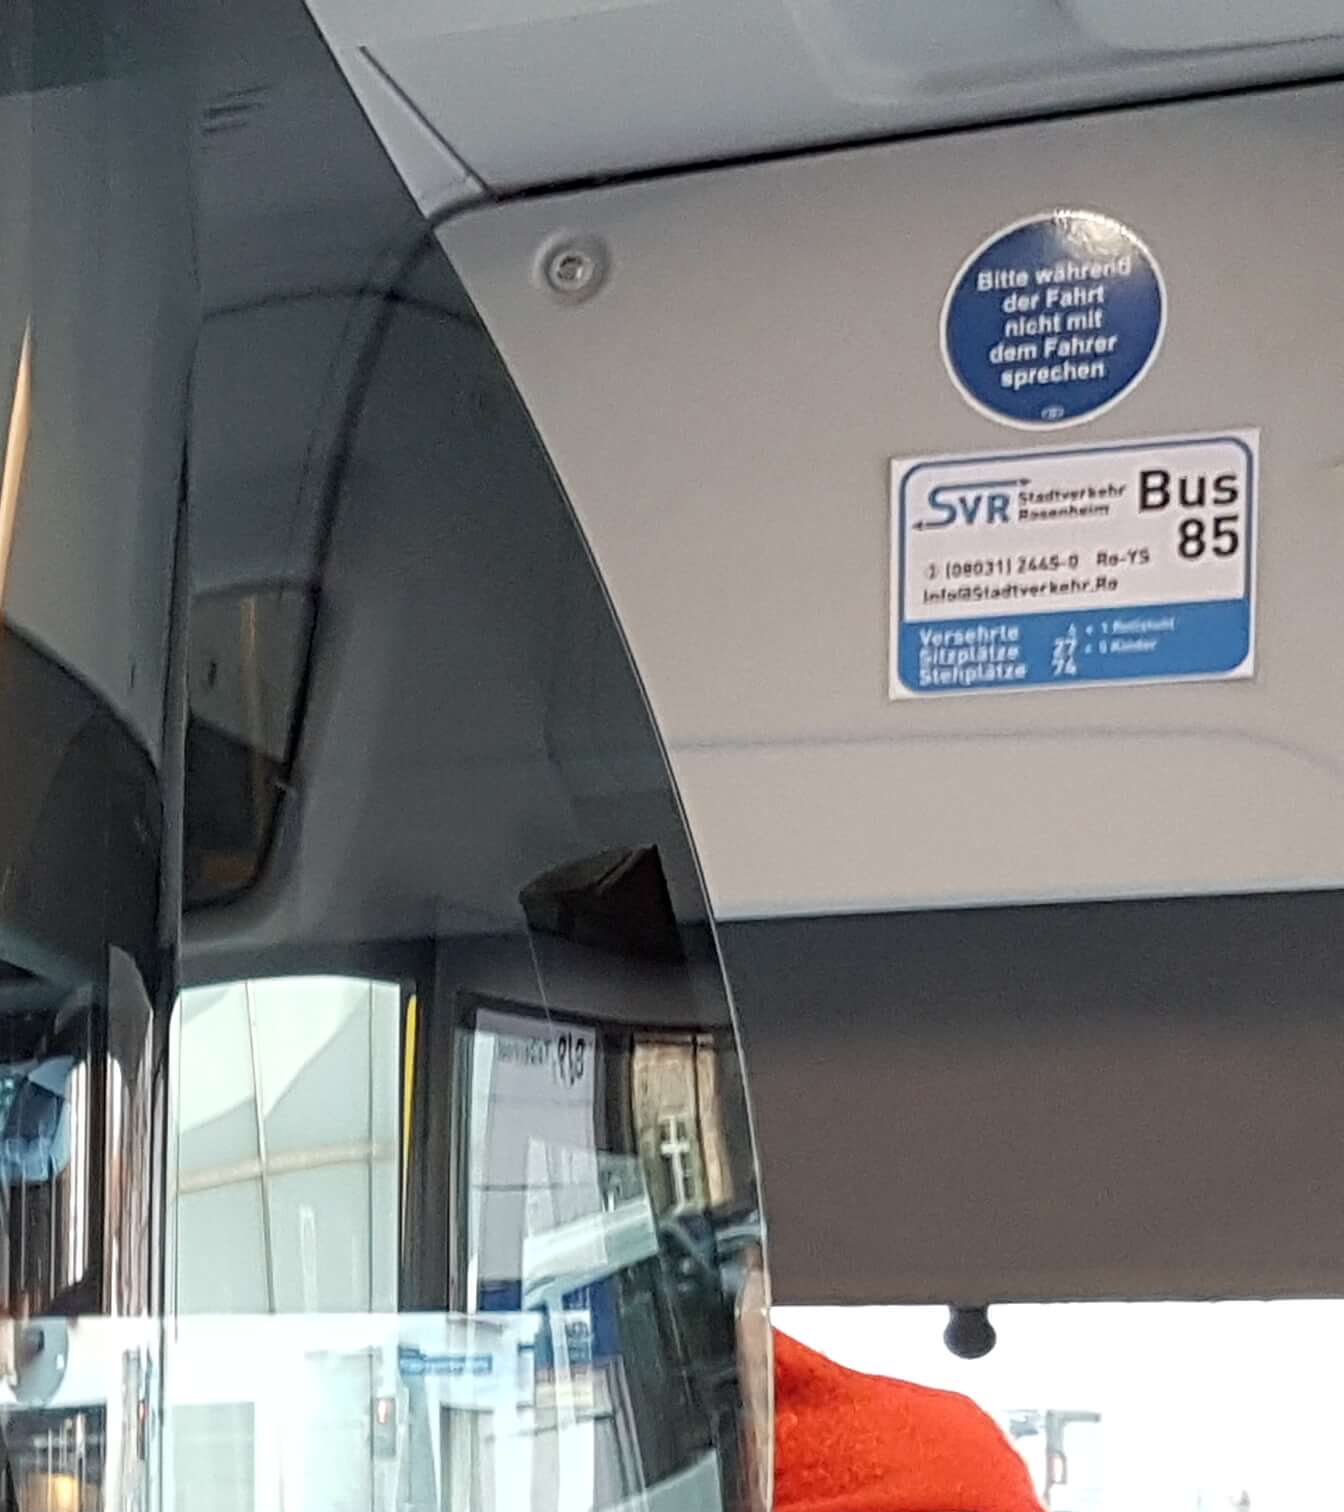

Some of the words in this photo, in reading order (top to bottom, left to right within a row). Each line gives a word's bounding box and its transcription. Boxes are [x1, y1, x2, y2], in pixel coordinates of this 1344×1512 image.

[977, 270, 1028, 291] Bitte
[1035, 256, 1131, 285] während
[1003, 294, 1039, 313] der
[1046, 286, 1104, 307] Fahrt
[1005, 313, 1061, 336] nicht
[1067, 309, 1102, 331] mit
[989, 342, 1037, 363] dem
[1044, 335, 1117, 358] Fahrer
[1001, 360, 1104, 390] sprechen
[928, 482, 1010, 527] SVR
[1018, 484, 1126, 504] Stadtverkehr
[1139, 470, 1238, 513] Bus
[1018, 503, 1110, 521] Rosenheim
[1178, 516, 1239, 559] 85
[919, 625, 1019, 647] Versehrte
[919, 662, 1026, 686] Stehplätze
